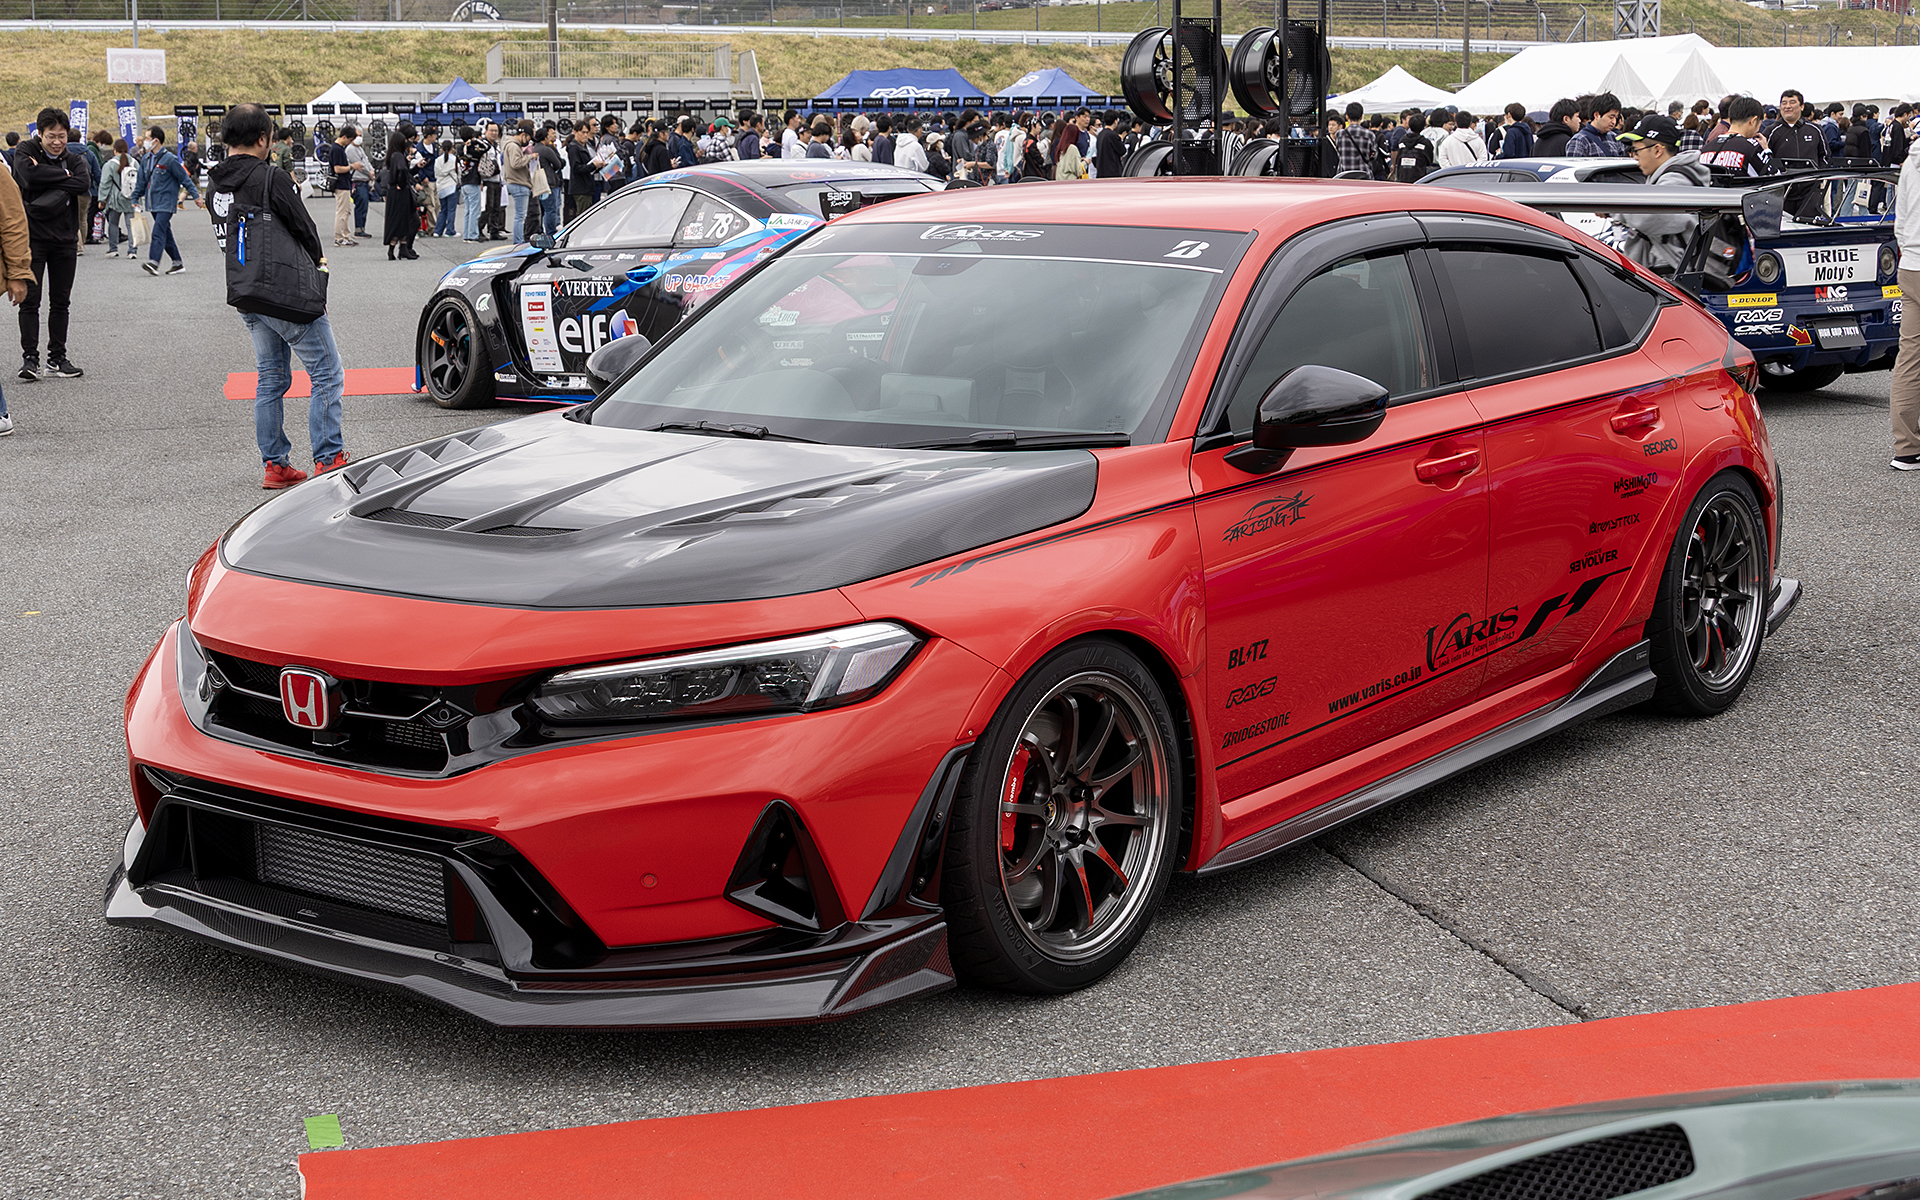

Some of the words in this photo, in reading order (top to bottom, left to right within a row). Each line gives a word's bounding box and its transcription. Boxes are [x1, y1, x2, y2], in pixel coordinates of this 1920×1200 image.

[112, 57, 161, 75] OUT
[704, 212, 734, 239] 78
[920, 224, 1045, 240] VARIS
[1807, 249, 1860, 265] BRIDE
[1815, 265, 1854, 281] Moty's
[565, 281, 614, 297] VERTEX
[665, 273, 683, 292] UP
[683, 274, 731, 292] GARAGE
[1738, 296, 1774, 304] DUNLOP
[1815, 285, 1848, 299] NAC
[1734, 308, 1784, 323] RAYS
[559, 314, 607, 354] elf
[1734, 323, 1785, 335] ORC
[1643, 438, 1678, 456] RECARO
[1613, 472, 1658, 493] HASHIMOTO
[1423, 605, 1519, 672] VARIS
[1227, 638, 1270, 670] BLITZ
[1225, 676, 1278, 709] RAYS
[1328, 665, 1422, 714] www.varis.co.jp
[1221, 711, 1291, 750] BRIDGESTONE
